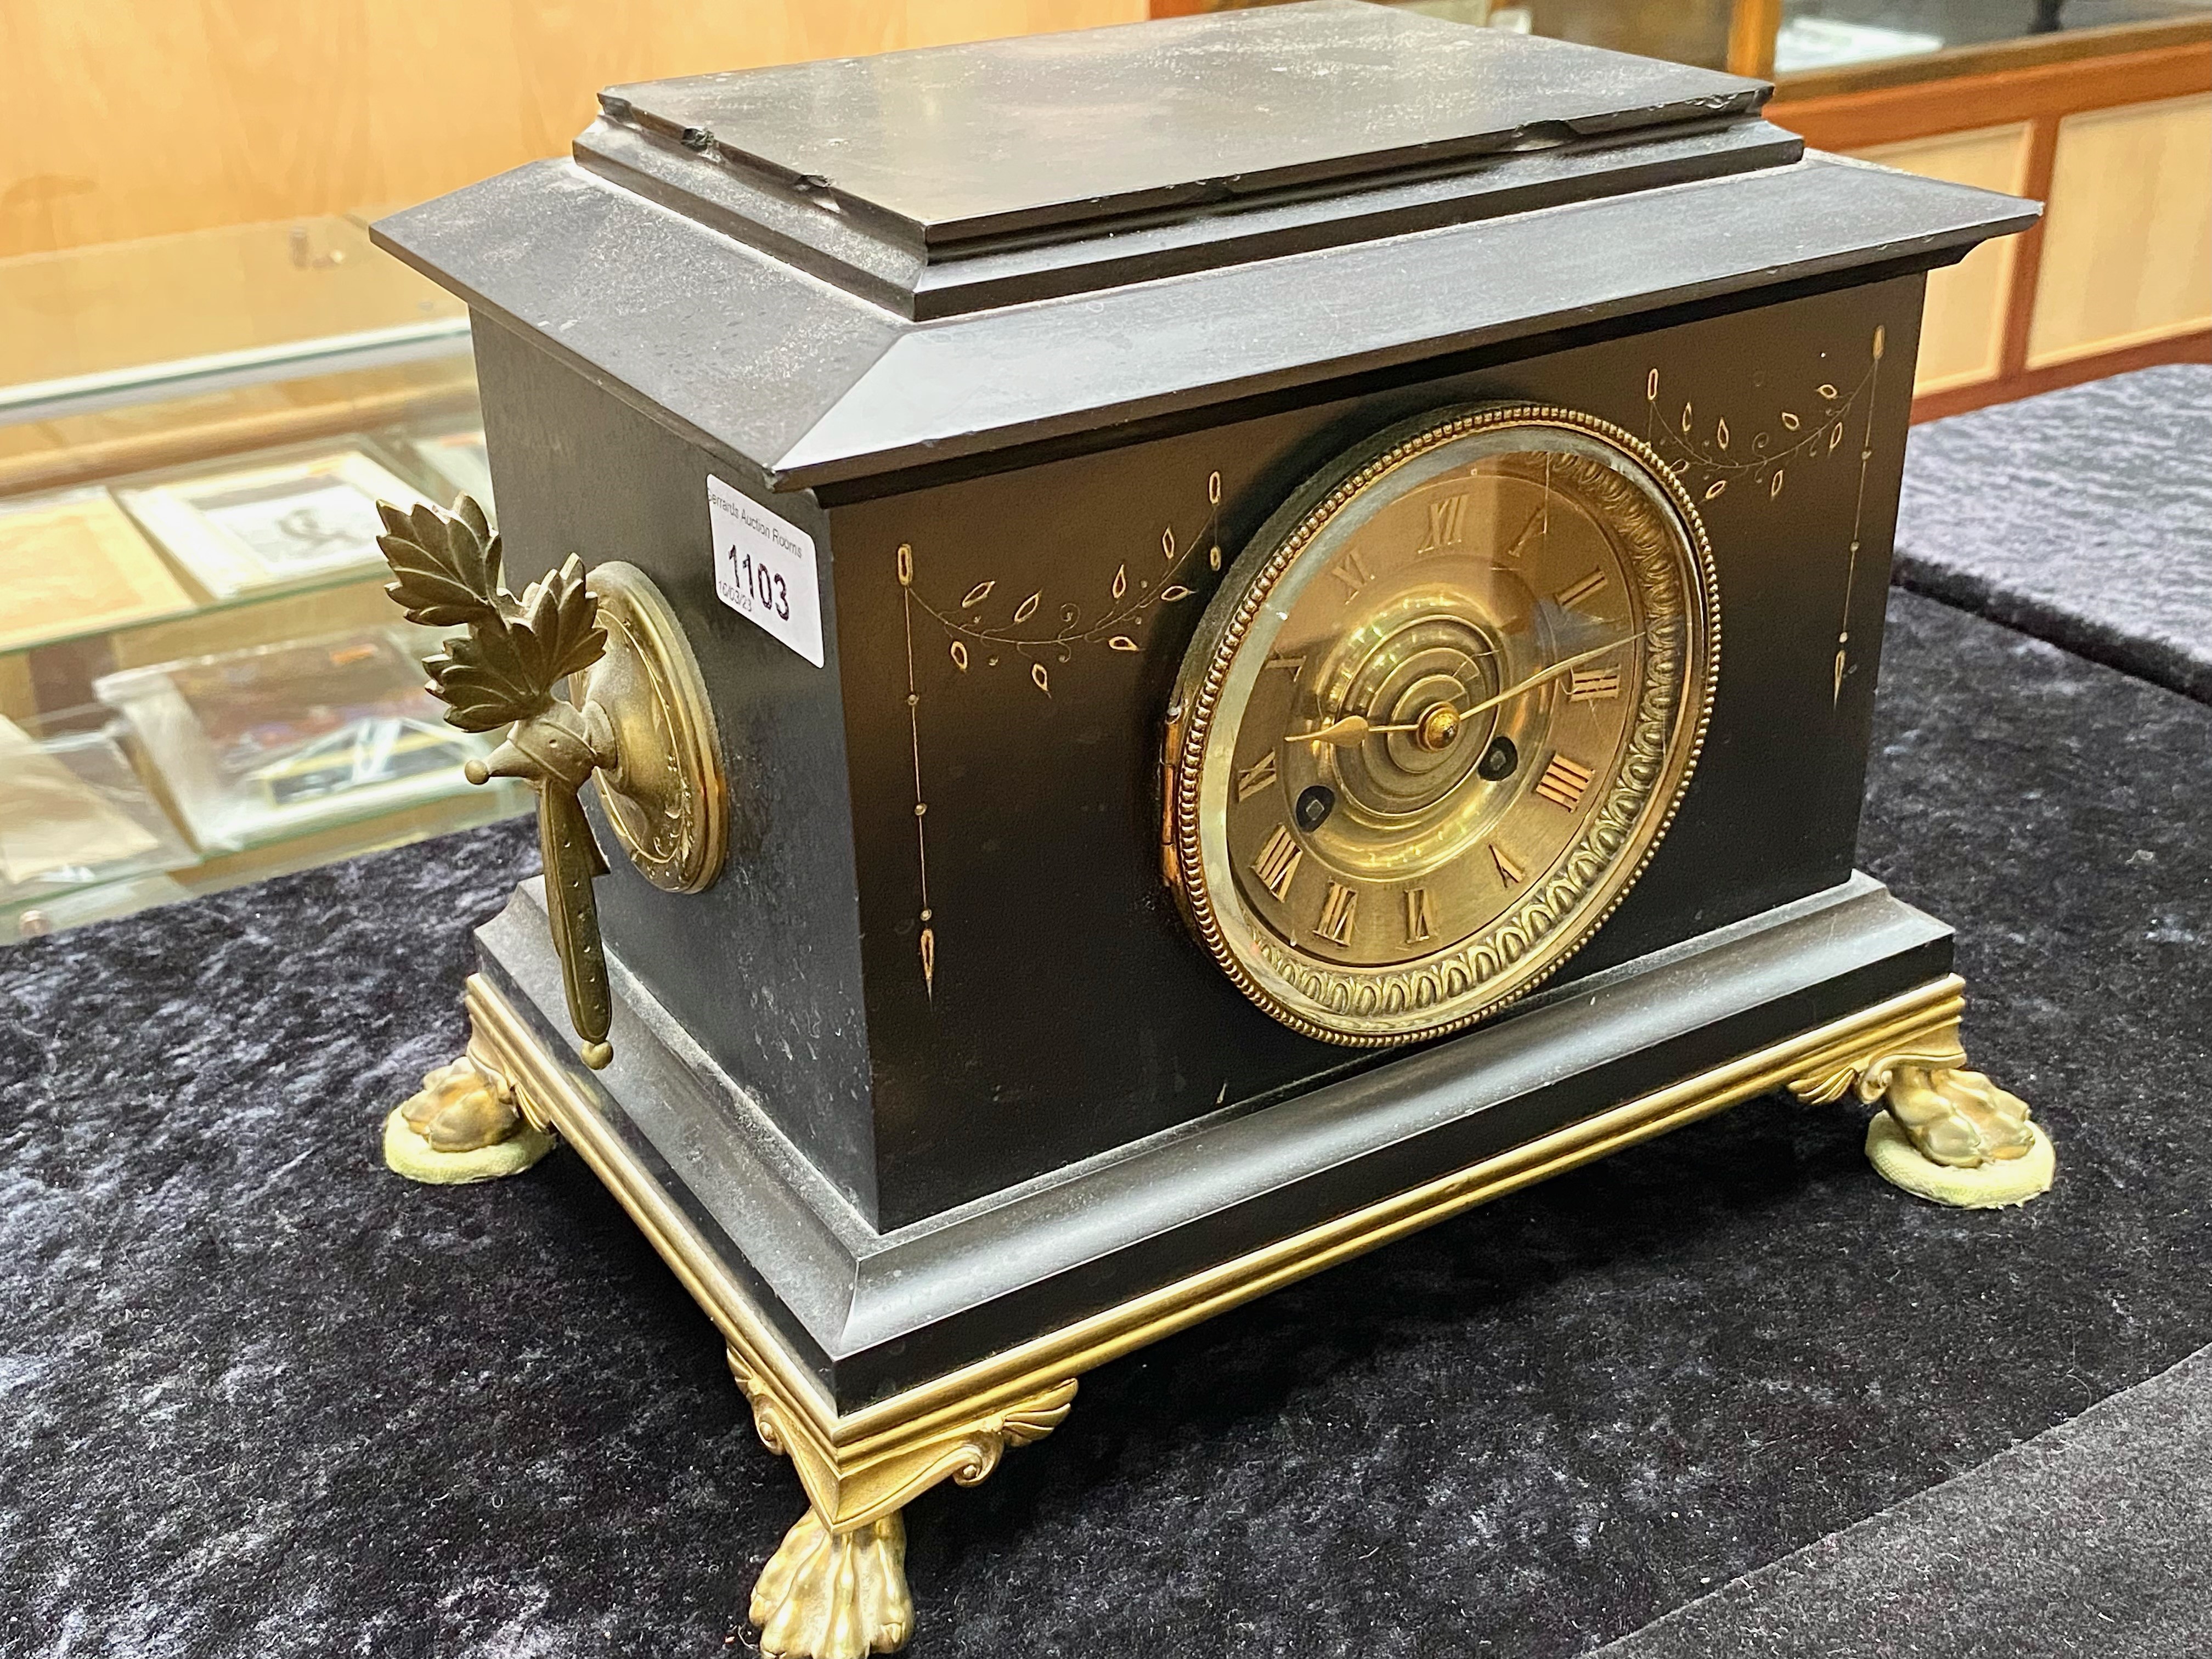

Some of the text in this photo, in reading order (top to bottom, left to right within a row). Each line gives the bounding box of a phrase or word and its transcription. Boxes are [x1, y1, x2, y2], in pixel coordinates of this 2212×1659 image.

[741, 509, 770, 539] Auction
[772, 528, 802, 559] Rooms
[1418, 494, 1469, 554] XII
[728, 544, 789, 621] 1103
[1331, 548, 1376, 606] XI
[1554, 565, 1608, 611] II
[1567, 662, 1621, 703] III
[1238, 747, 1277, 803] IX
[1534, 753, 1595, 813] IIII
[1248, 823, 1303, 903] VIII
[1487, 843, 1526, 888] V
[1312, 877, 1358, 947] VII
[1402, 887, 1439, 944] VI
